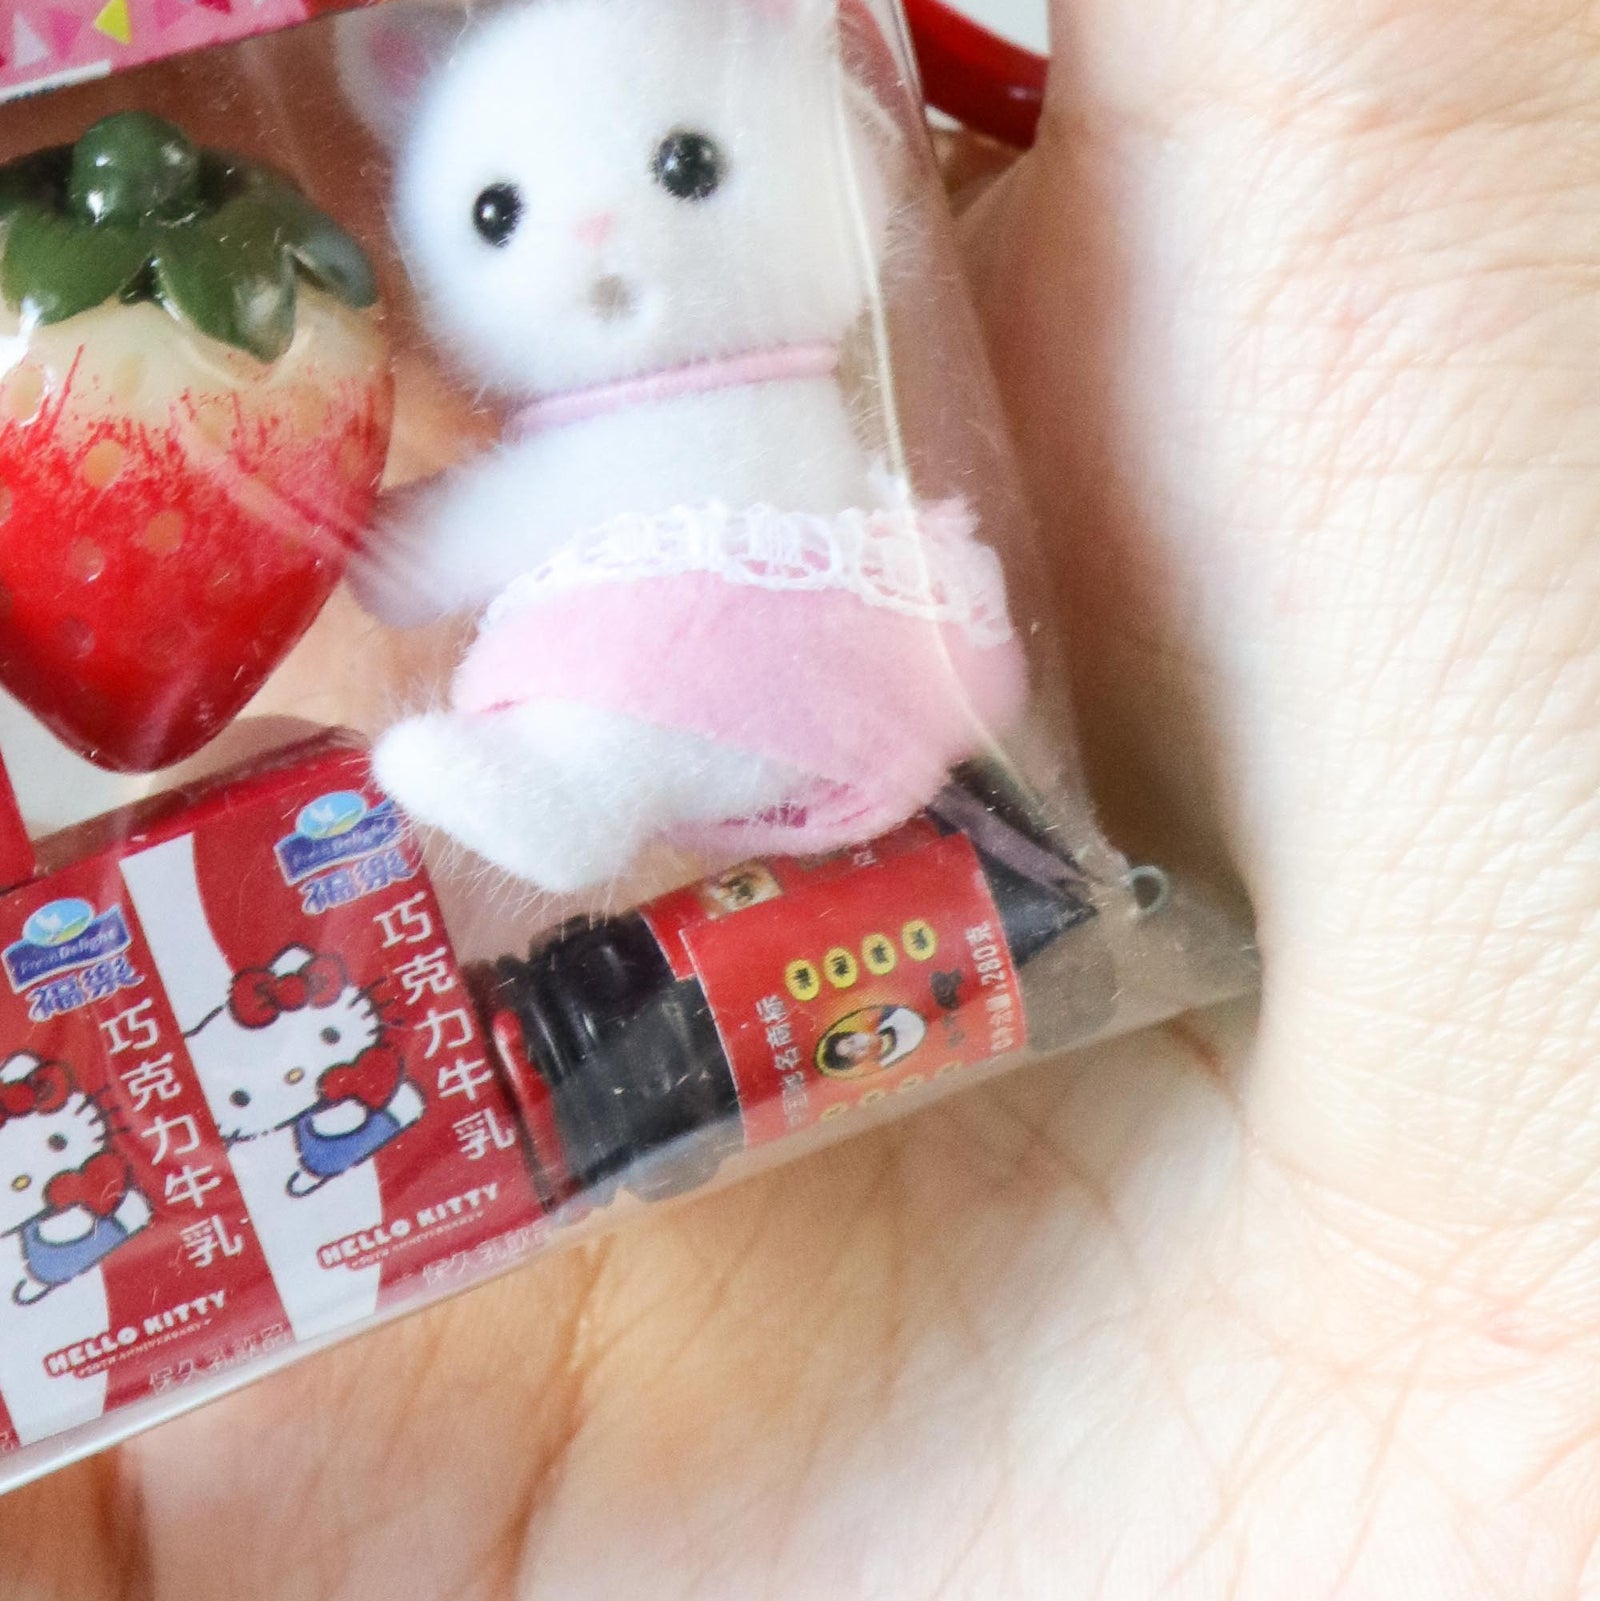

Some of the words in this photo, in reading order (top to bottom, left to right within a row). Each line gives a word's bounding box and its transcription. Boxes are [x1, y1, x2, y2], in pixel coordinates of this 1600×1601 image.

[373, 891, 520, 1161] 巧克力牛乳
[99, 998, 247, 1270] 巧克力牛乳
[318, 1216, 414, 1265] HELLO
[413, 1181, 503, 1227] KITTY
[45, 1323, 140, 1373] HELLO
[140, 1289, 229, 1335] KITTY
